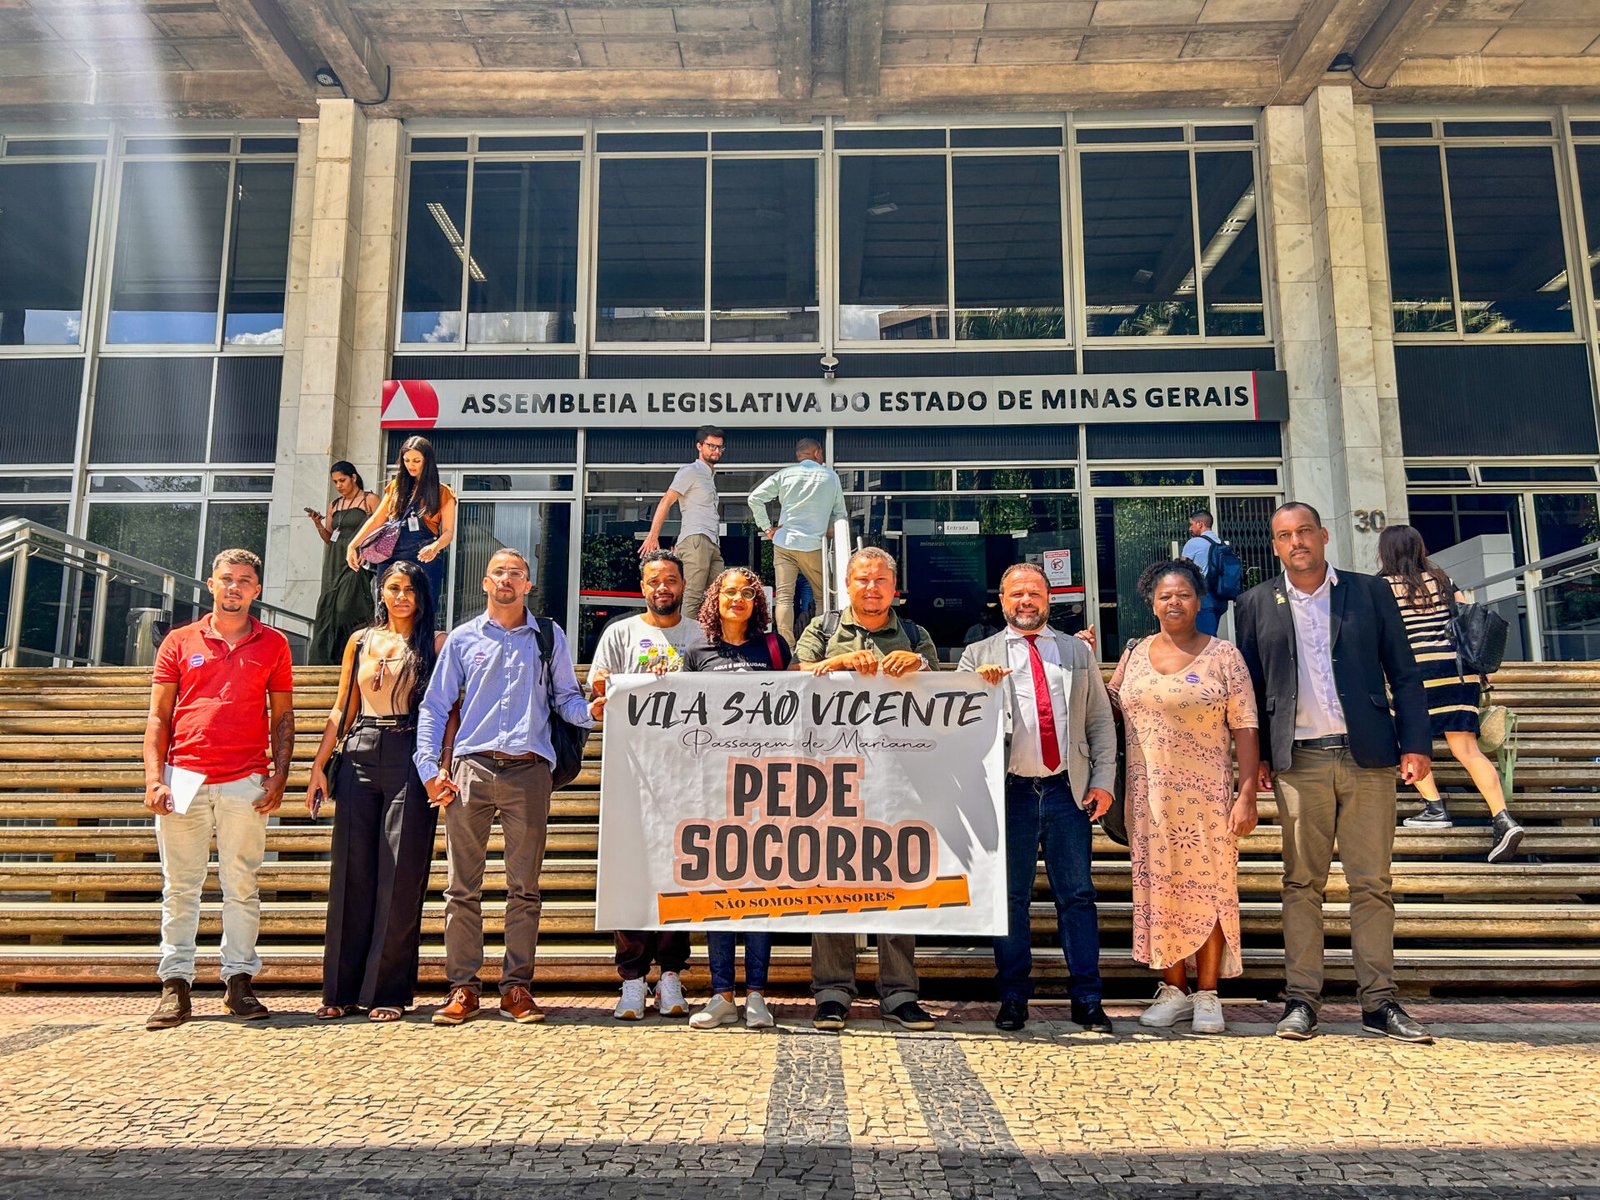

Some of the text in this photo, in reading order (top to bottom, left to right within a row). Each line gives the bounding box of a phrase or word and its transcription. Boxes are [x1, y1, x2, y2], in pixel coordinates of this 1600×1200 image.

[461, 385, 1249, 414] ASSEMBLEIA LEGISLATIVA DO ESTADO DE MINAS GERAIS
[1354, 509, 1385, 533] 30
[627, 682, 988, 728] VILA SÃO VICENTE
[682, 728, 932, 757] Passagem de Mariana
[733, 762, 858, 818] PEDE
[680, 824, 930, 883] SOCORRO
[714, 890, 896, 910] NÃO SOMOS INVASORES
